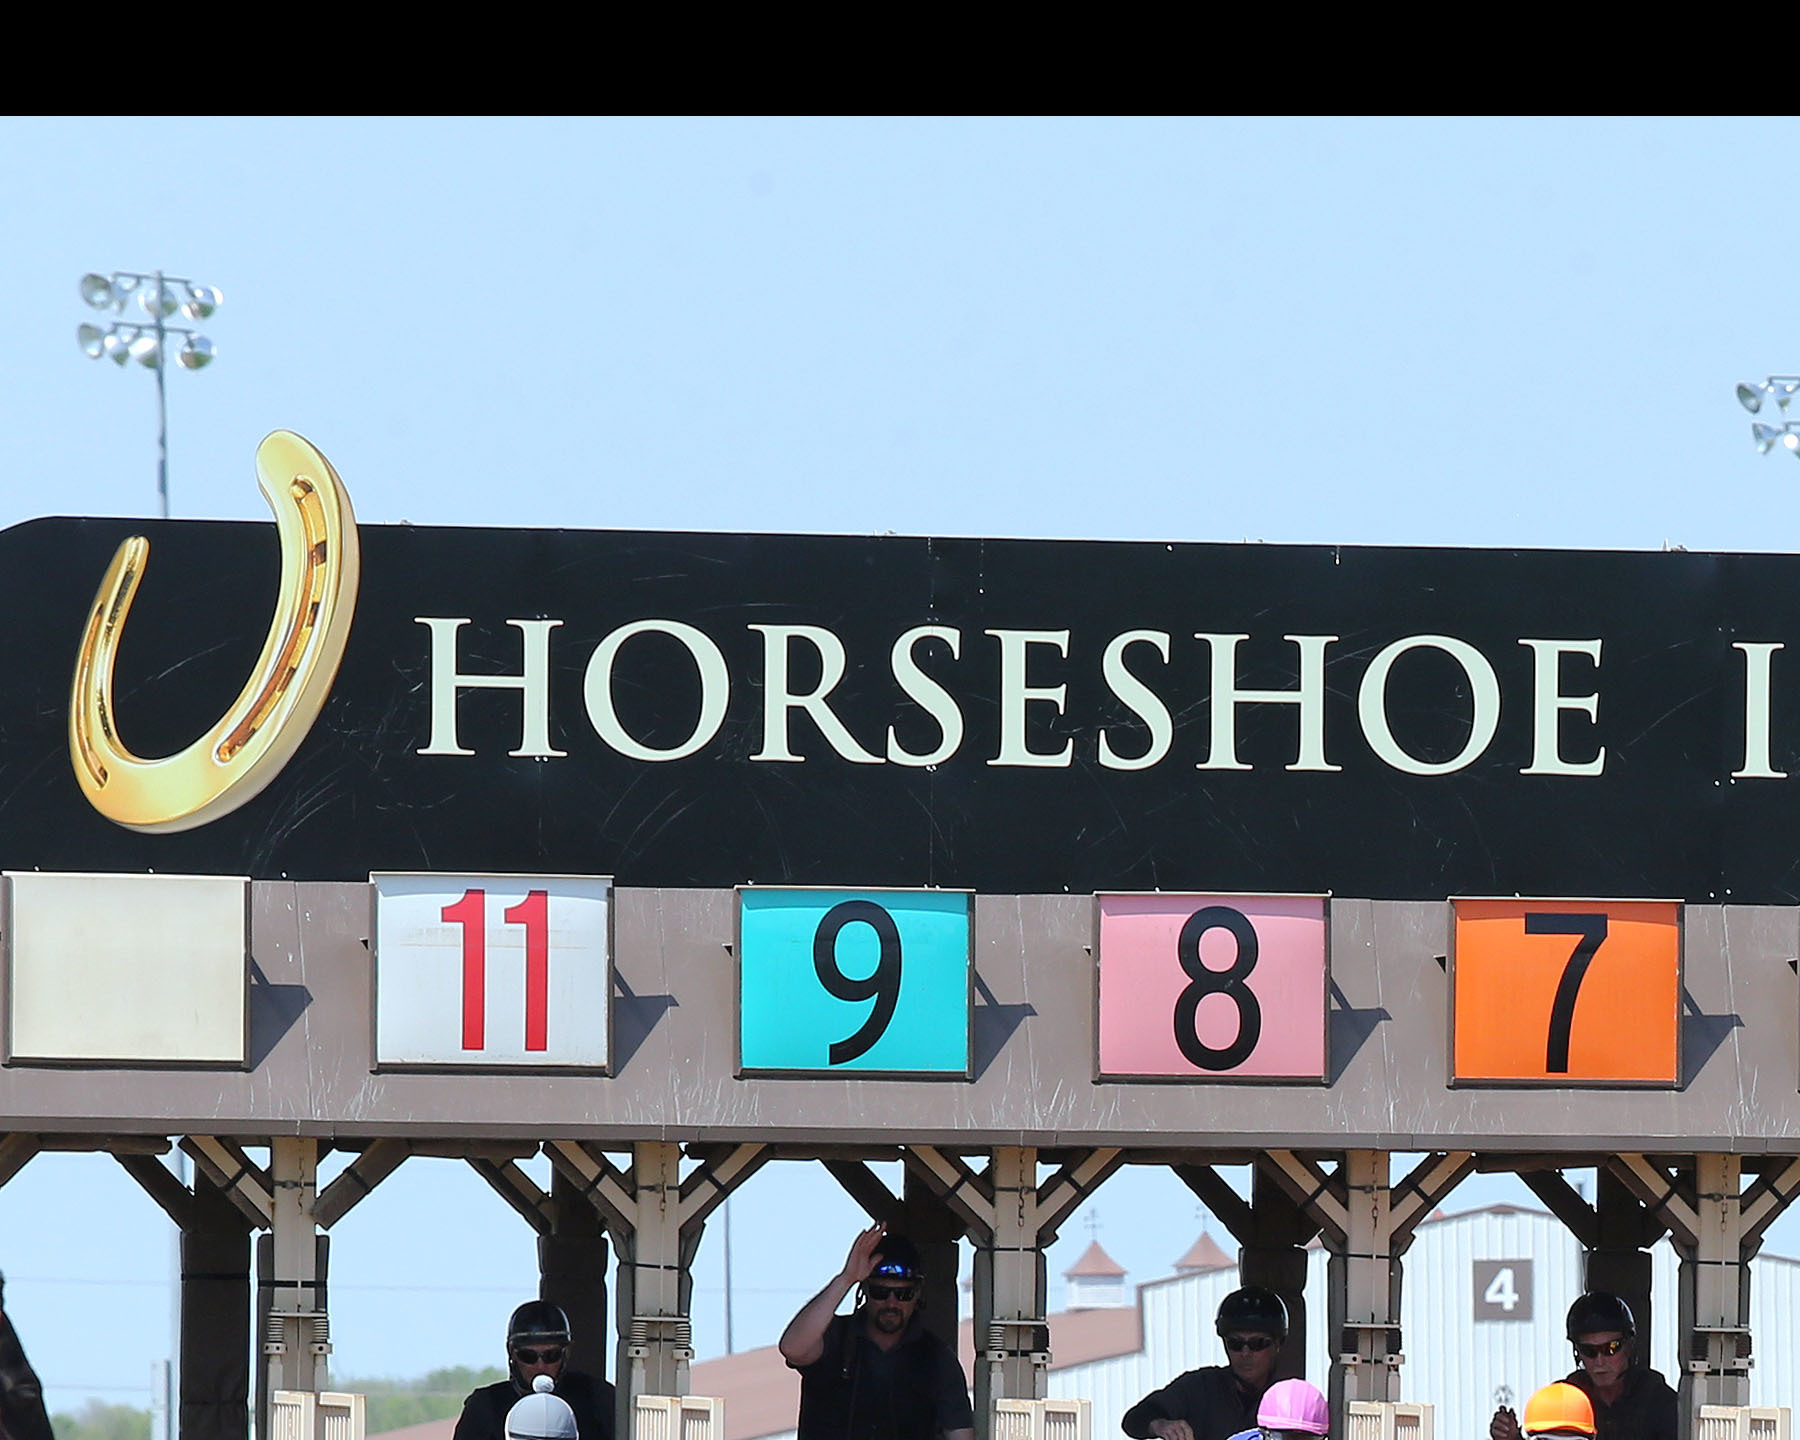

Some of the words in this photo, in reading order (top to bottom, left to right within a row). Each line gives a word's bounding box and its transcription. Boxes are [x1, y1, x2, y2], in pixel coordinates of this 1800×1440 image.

[415, 616, 1606, 777] HORSESHOE
[442, 890, 548, 1052] 11
[813, 899, 902, 1066] 9
[1173, 905, 1262, 1071] 8
[1524, 912, 1608, 1074] 7
[1484, 1267, 1520, 1311] 4
